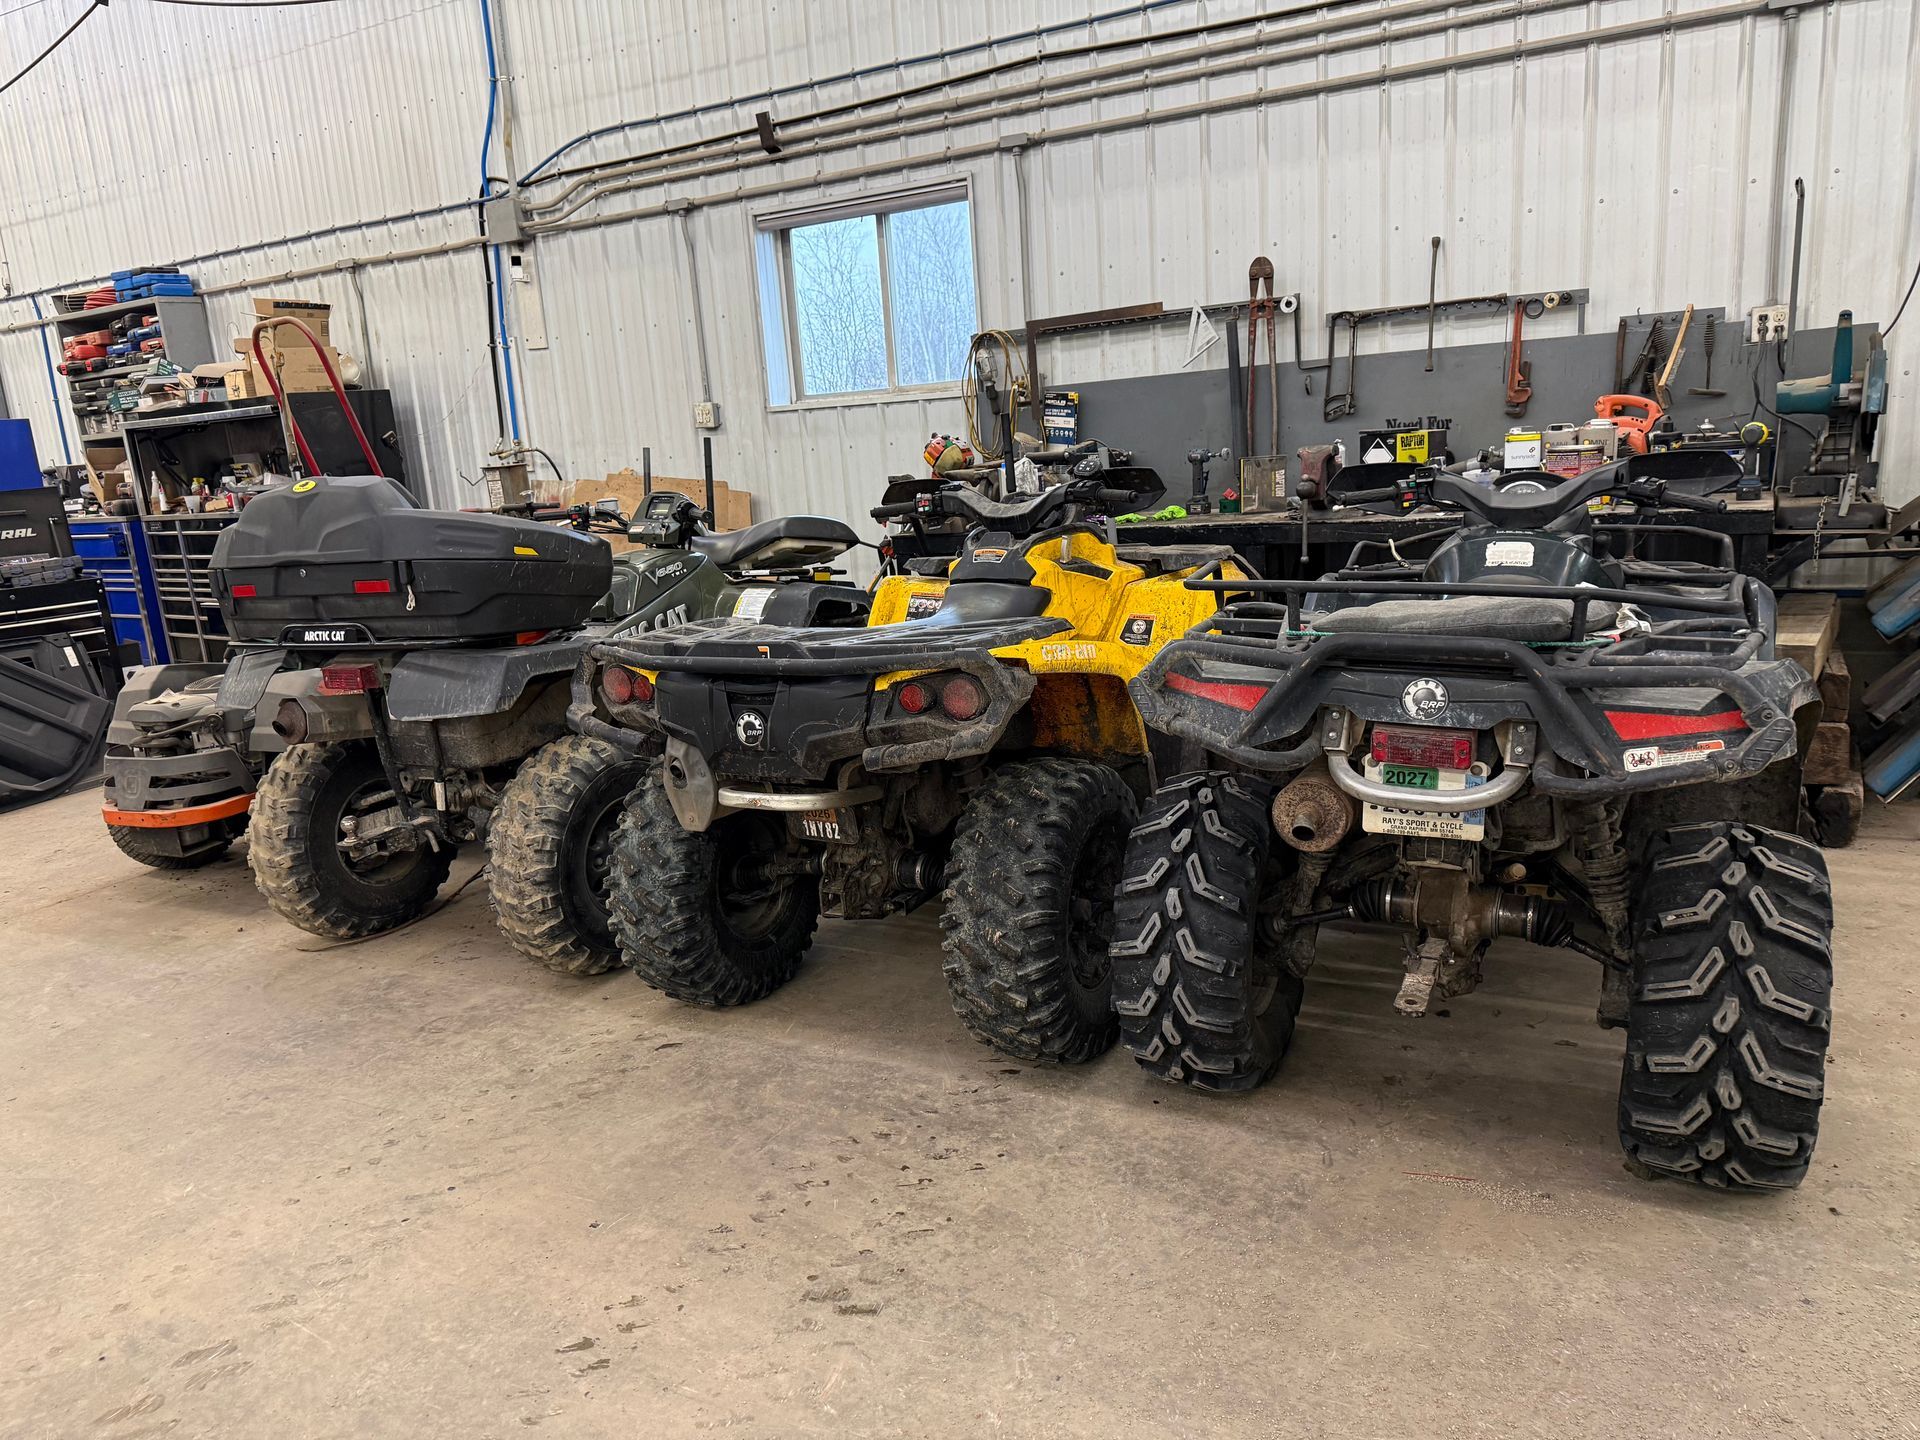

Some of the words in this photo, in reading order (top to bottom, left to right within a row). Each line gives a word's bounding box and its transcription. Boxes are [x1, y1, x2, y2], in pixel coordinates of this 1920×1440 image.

[1427, 416, 1453, 430] For
[1400, 434, 1425, 448] RAPTOR
[1275, 469, 1285, 497] RAPTOR
[1, 527, 37, 539] RAL
[654, 603, 688, 630] CAT
[304, 630, 330, 641] ARCTIC
[331, 630, 345, 641] CAT
[1420, 700, 1445, 709] BRP
[1385, 770, 1429, 786] 2027
[1382, 817, 1404, 826] RAY'S
[1405, 819, 1430, 828] SPORT
[1439, 822, 1464, 831] CYCLE
